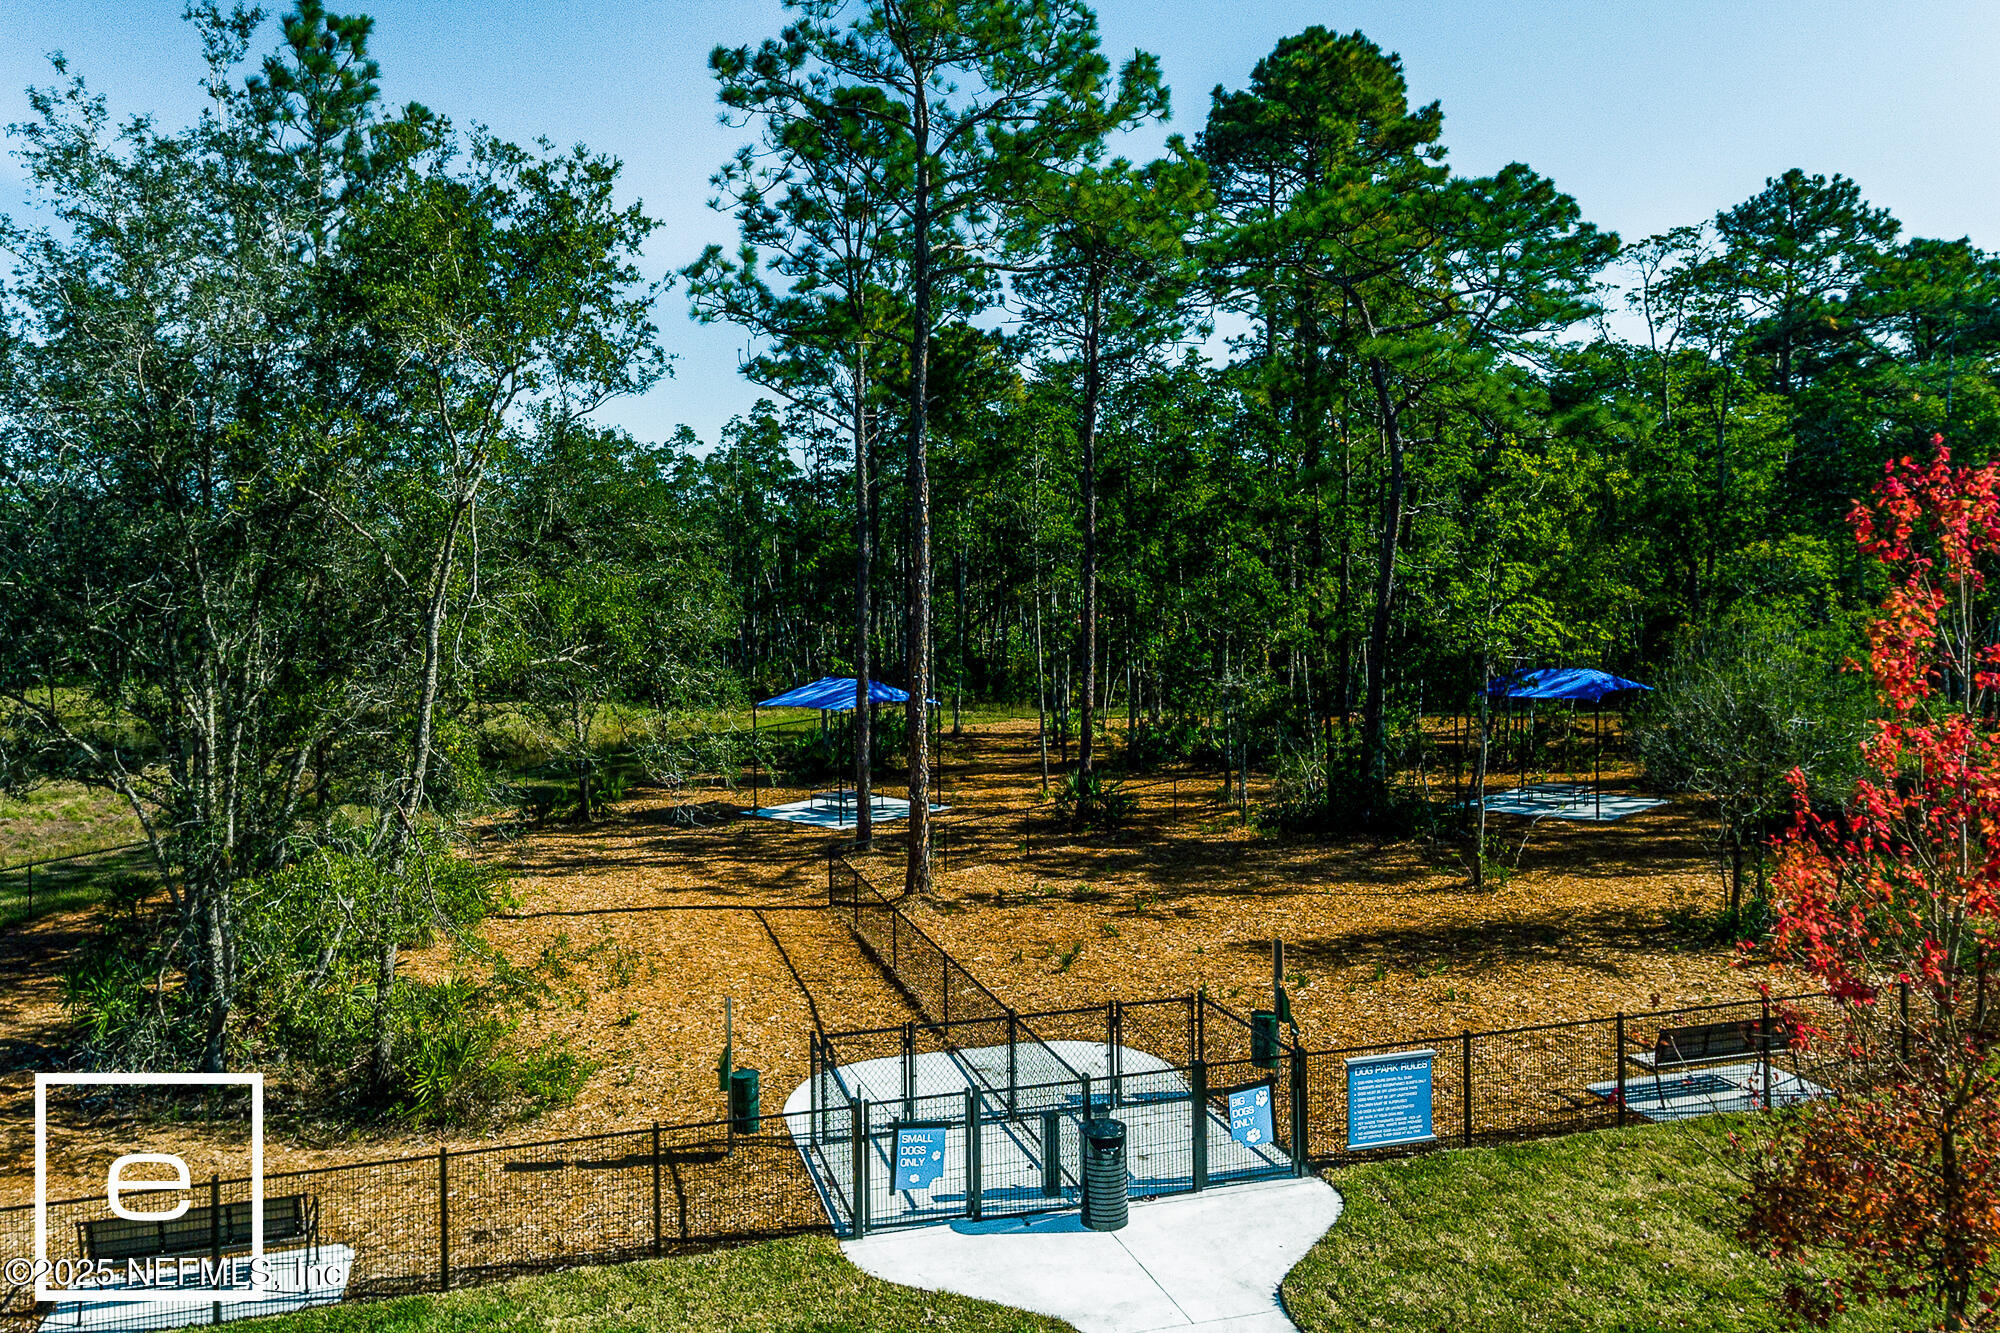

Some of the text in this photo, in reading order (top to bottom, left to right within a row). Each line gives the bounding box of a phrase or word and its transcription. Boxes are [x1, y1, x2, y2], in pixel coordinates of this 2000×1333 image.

[1355, 1060, 1428, 1076] DOG PARK RULES
[1231, 1096, 1245, 1108] BIG
[1232, 1105, 1255, 1118] DOGS
[1233, 1116, 1255, 1129] ONLY
[901, 1134, 933, 1143] SMALL
[901, 1146, 926, 1155] DOGS
[900, 1158, 925, 1167] ONLY
